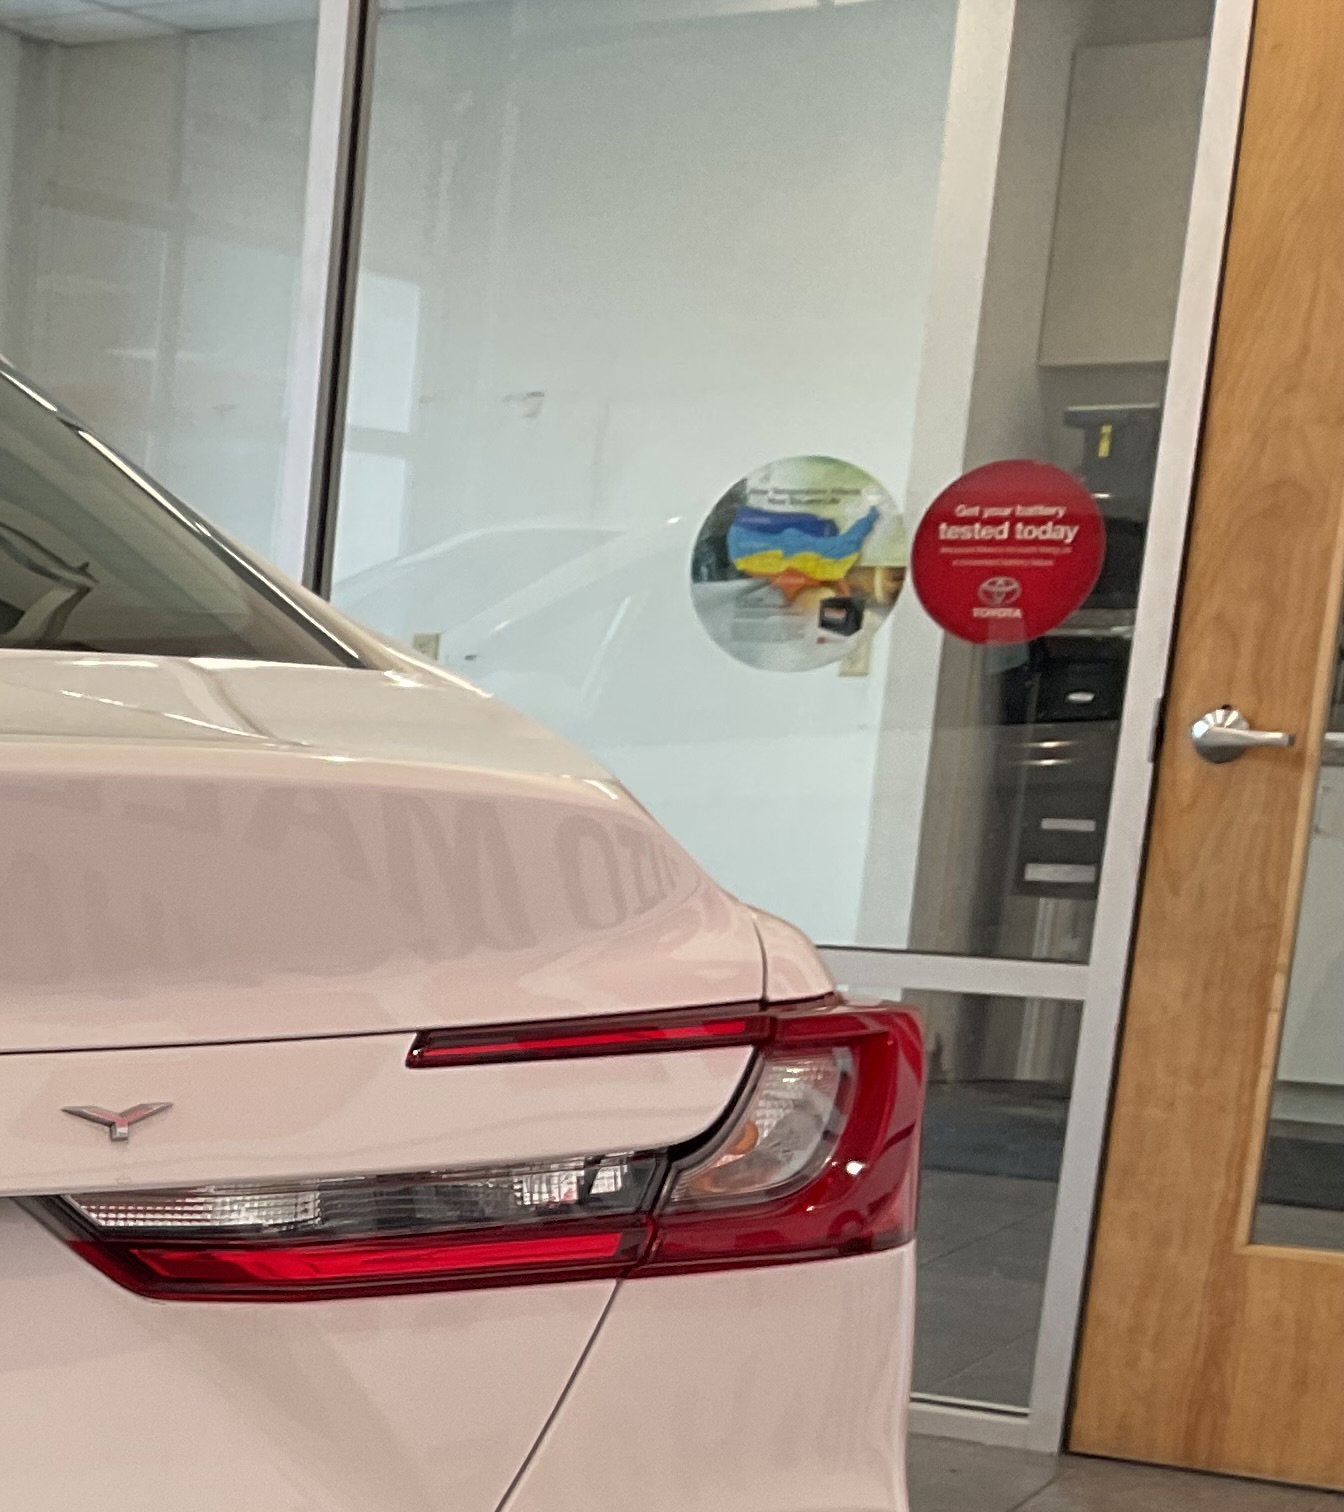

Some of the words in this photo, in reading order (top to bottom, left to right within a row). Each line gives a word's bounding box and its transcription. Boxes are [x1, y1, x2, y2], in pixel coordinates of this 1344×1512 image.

[954, 504, 980, 517] Get
[982, 506, 1012, 518] your
[1015, 504, 1067, 518] battery
[938, 521, 1010, 540] tested
[1015, 521, 1079, 543] today
[972, 607, 1022, 618] TOYOTA
